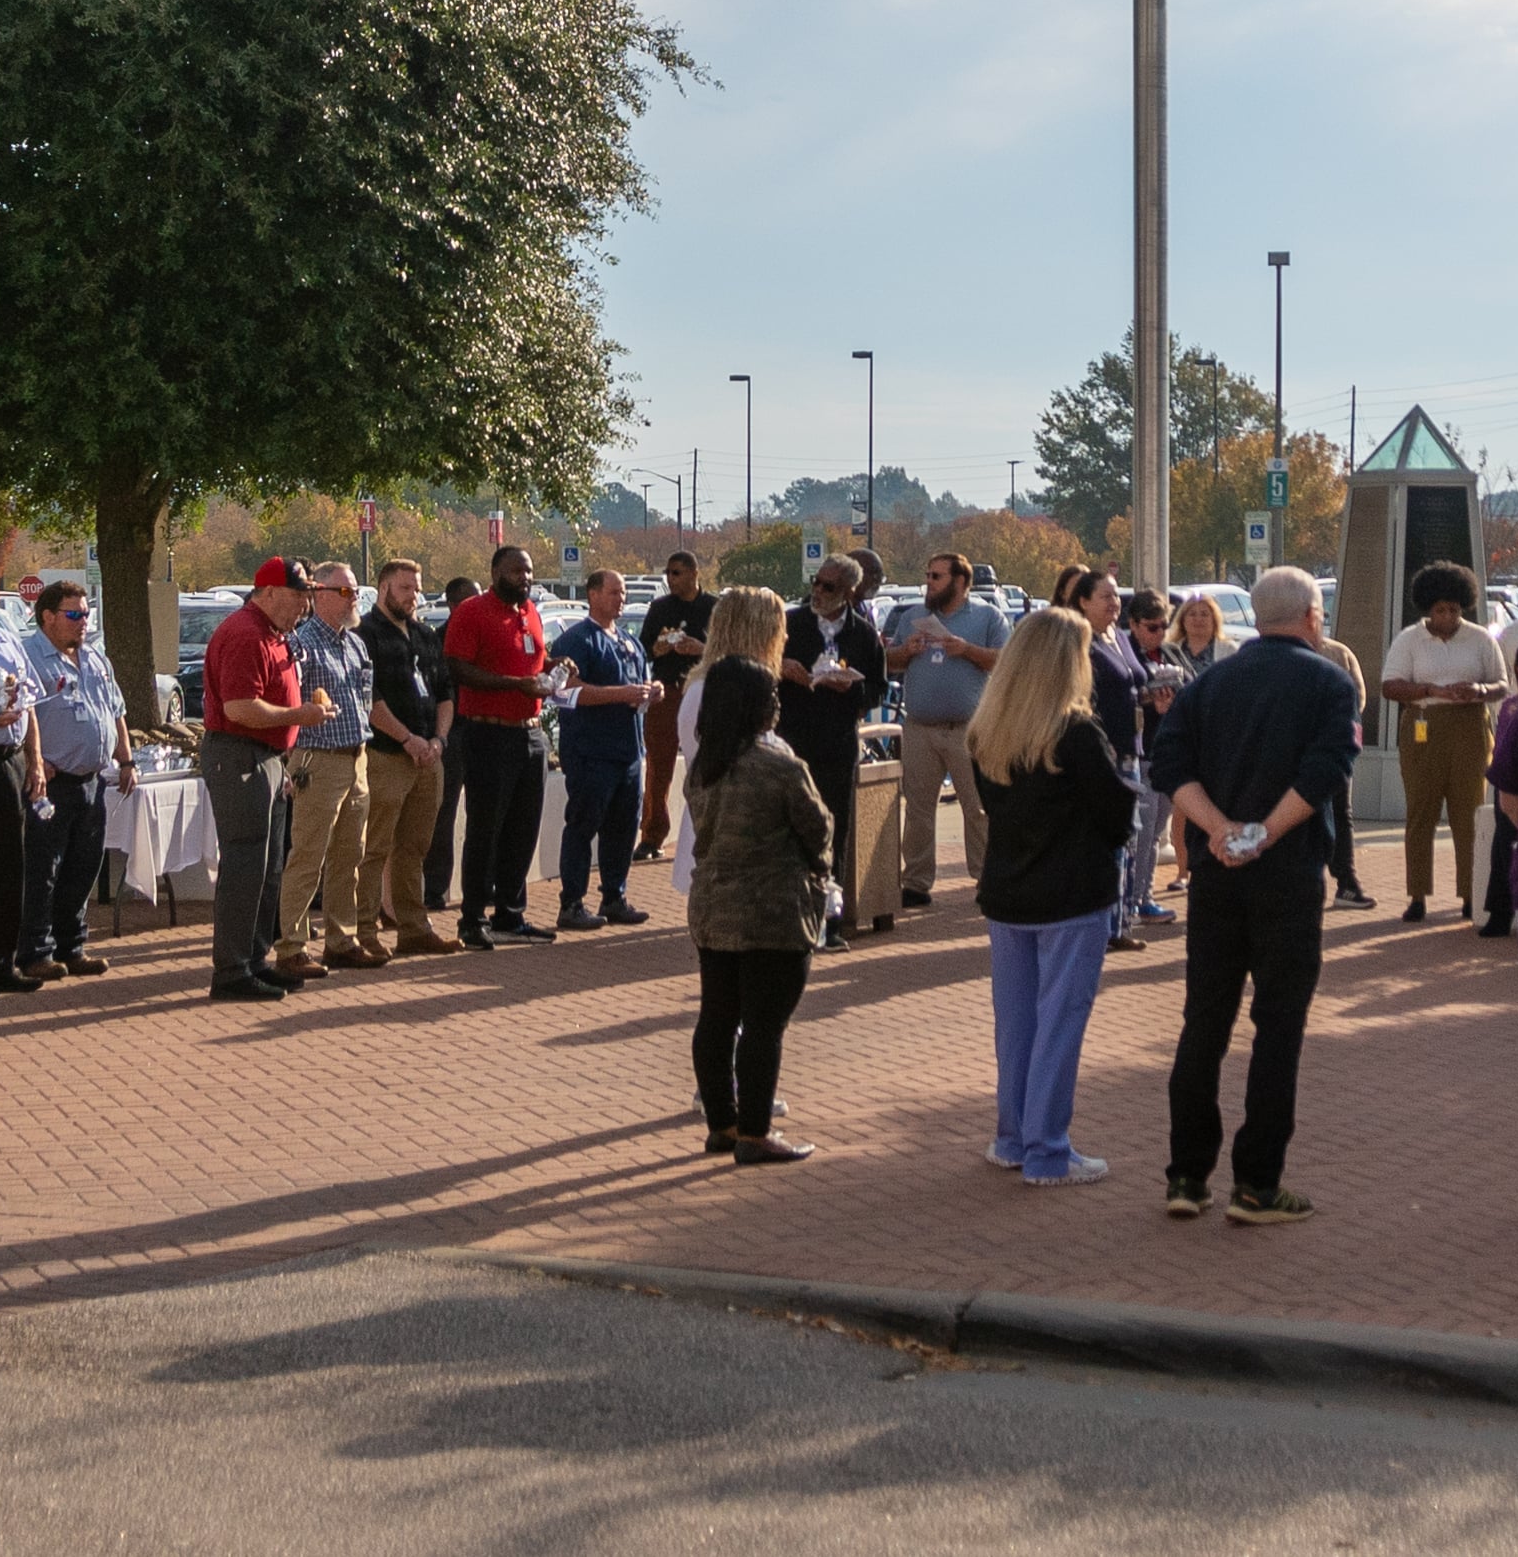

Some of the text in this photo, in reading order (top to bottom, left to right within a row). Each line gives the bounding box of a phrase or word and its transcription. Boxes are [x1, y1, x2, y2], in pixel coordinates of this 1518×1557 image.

[1271, 473, 1284, 497] 5
[363, 503, 372, 523] 4
[19, 582, 44, 594] STOP
